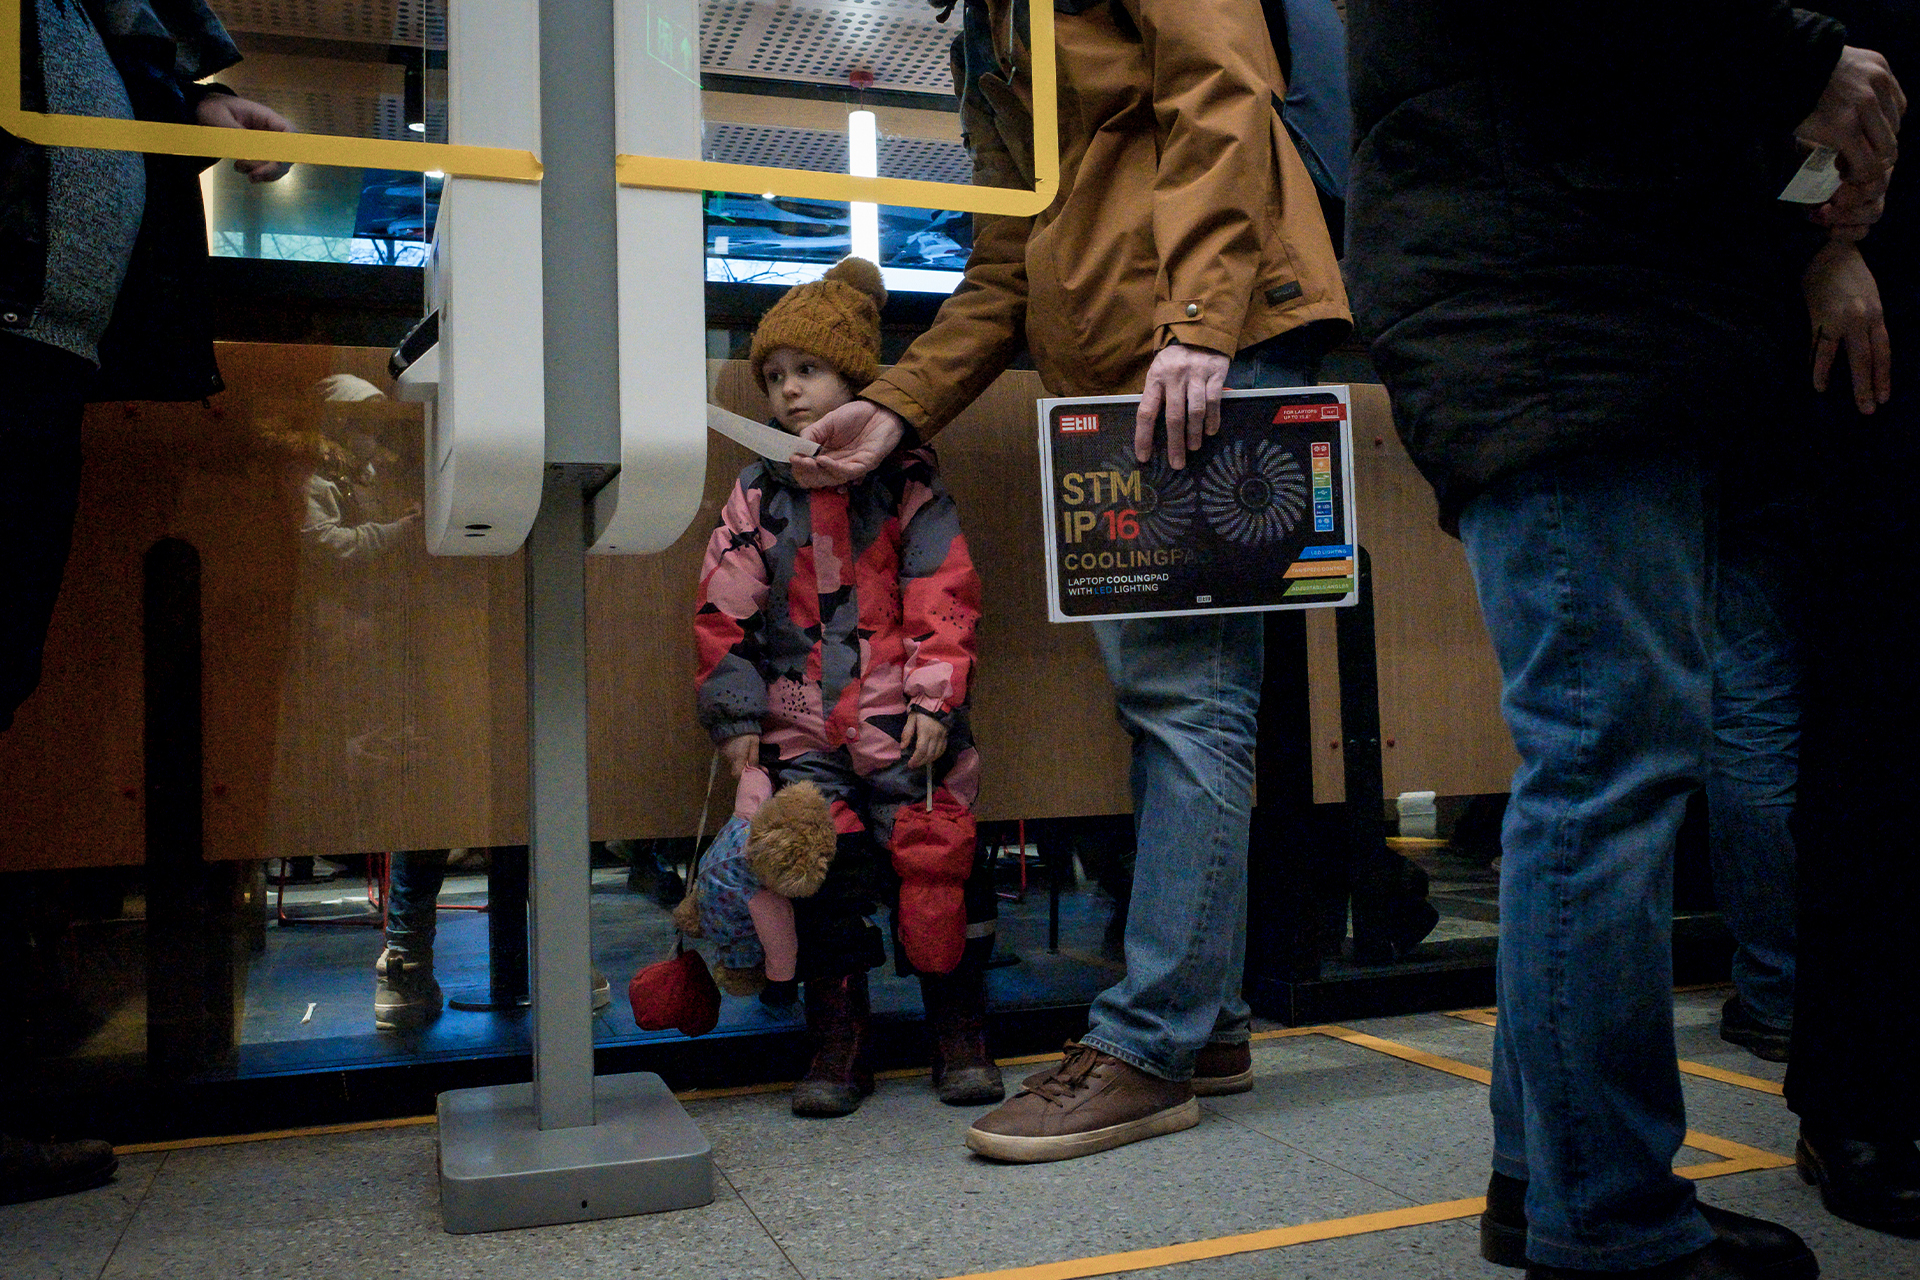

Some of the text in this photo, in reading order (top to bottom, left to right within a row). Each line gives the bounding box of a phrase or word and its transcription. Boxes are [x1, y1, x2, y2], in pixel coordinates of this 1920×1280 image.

[1063, 470, 1142, 505] STM
[1064, 508, 1141, 544] IP 16
[1068, 573, 1170, 587] LAPTOP COOLINGPAD
[1068, 583, 1159, 596] WITH LED LIGHTING
